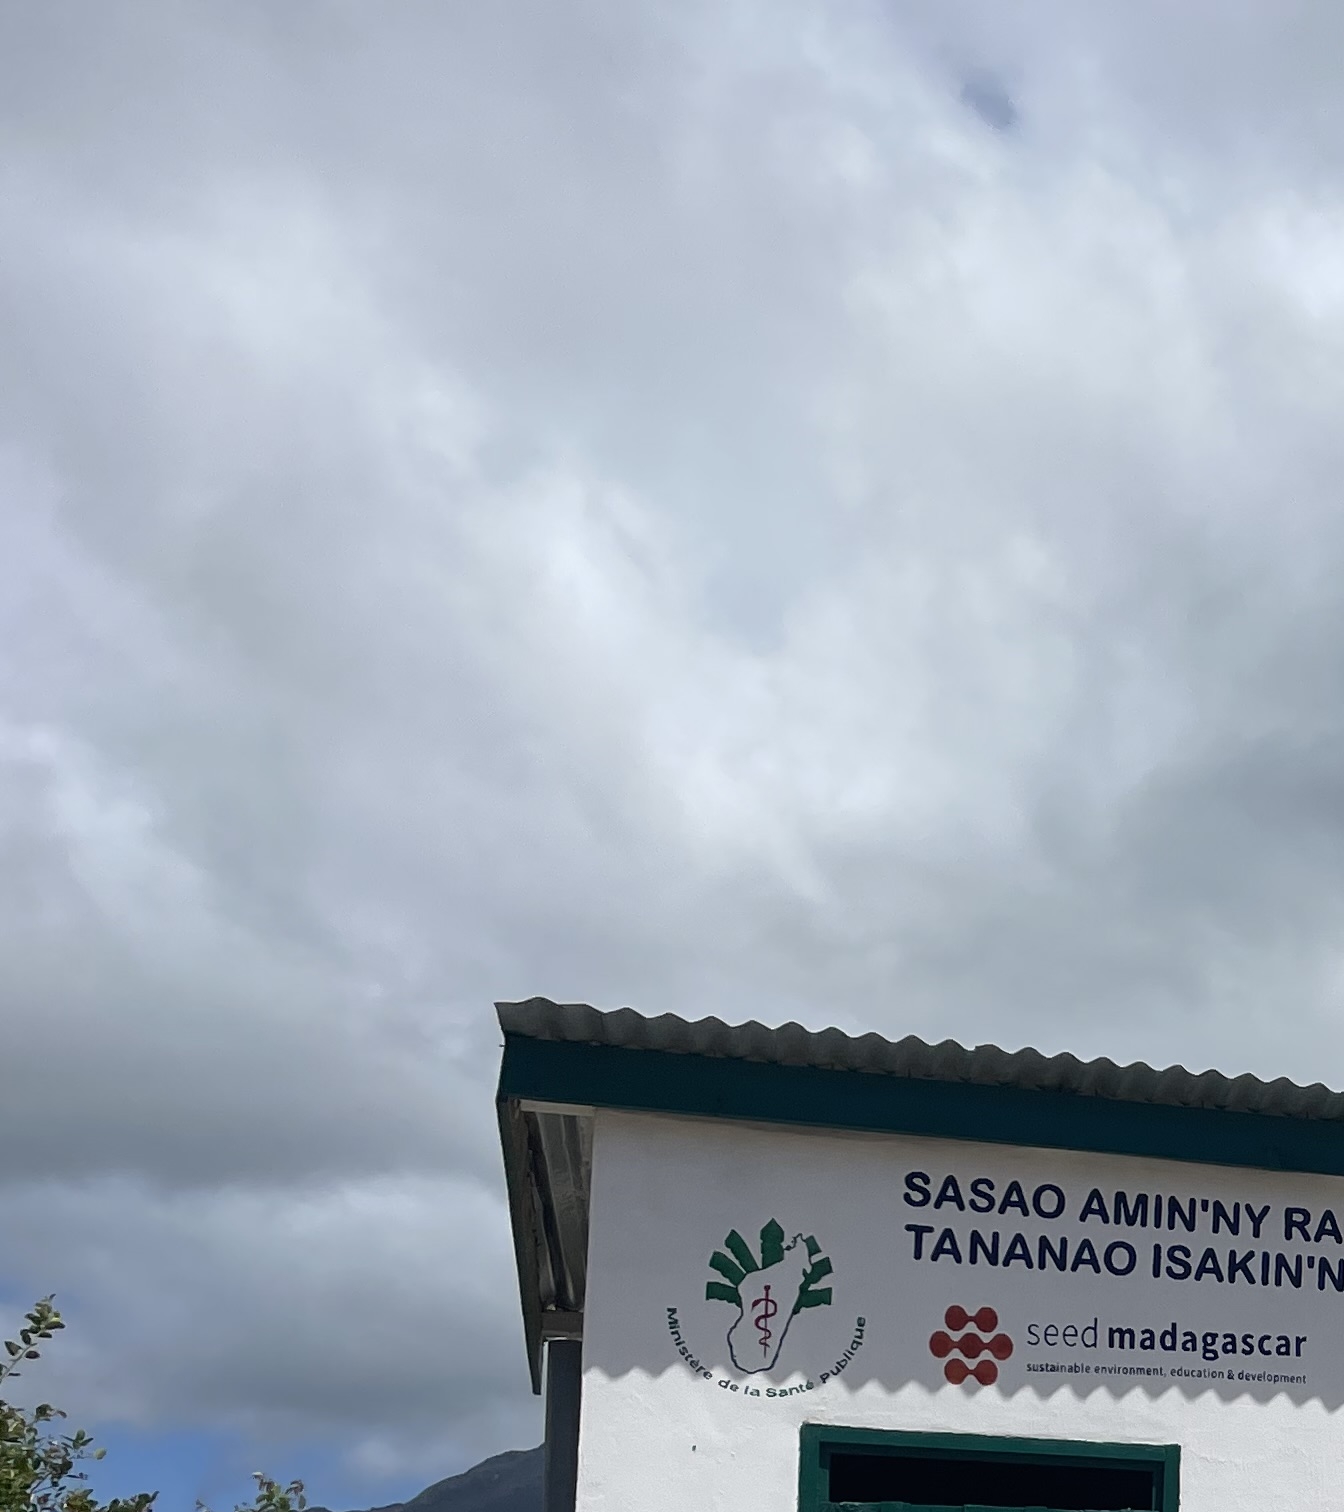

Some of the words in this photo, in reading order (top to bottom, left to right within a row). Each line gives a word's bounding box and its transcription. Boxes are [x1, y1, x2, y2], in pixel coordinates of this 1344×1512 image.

[903, 1171, 1066, 1219] SASAO
[1079, 1188, 1271, 1238] AMIN'NY
[904, 1223, 1137, 1276] TANANAO
[717, 1378, 739, 1393] de
[743, 1385, 760, 1397] la
[765, 1379, 815, 1398] Santé
[818, 1316, 866, 1384] Publique
[1026, 1317, 1098, 1348] seed
[1107, 1322, 1308, 1361] madagascar
[1026, 1362, 1091, 1374] sustainable
[1093, 1365, 1167, 1378] environment,
[1170, 1366, 1224, 1380] education
[1226, 1369, 1235, 1381] &
[1237, 1369, 1307, 1384] development
